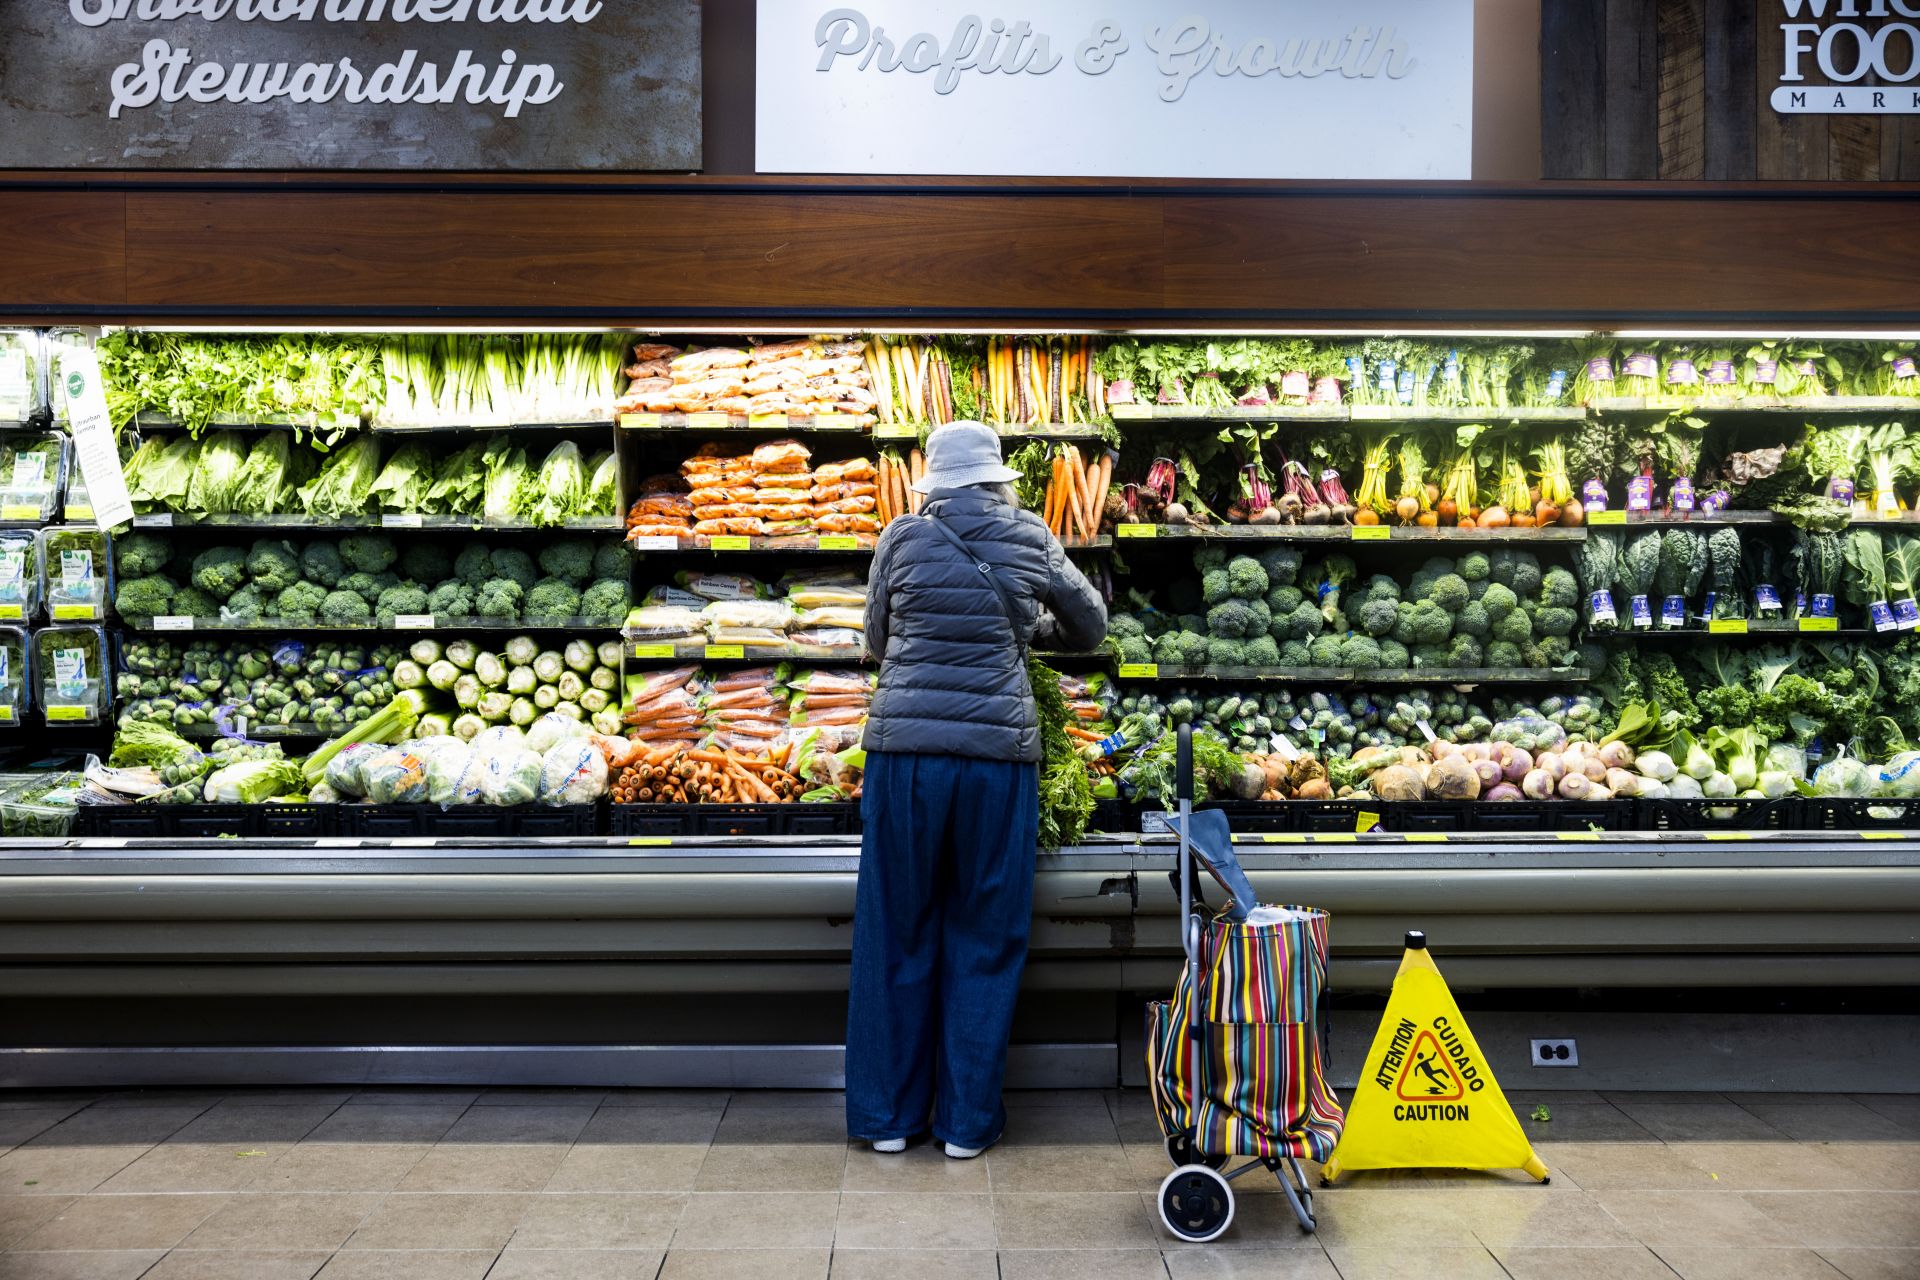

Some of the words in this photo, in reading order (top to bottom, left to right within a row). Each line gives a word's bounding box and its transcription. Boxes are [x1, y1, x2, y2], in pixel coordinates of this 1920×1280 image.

[108, 38, 564, 118] Stewardship
[815, 8, 1062, 94] Profits
[1075, 18, 1128, 75] &
[1145, 14, 1418, 102] Growth
[1375, 1018, 1417, 1091] ATTENTION
[1433, 1016, 1484, 1092] CUIDADO
[1394, 1105, 1469, 1121] CAUTION
